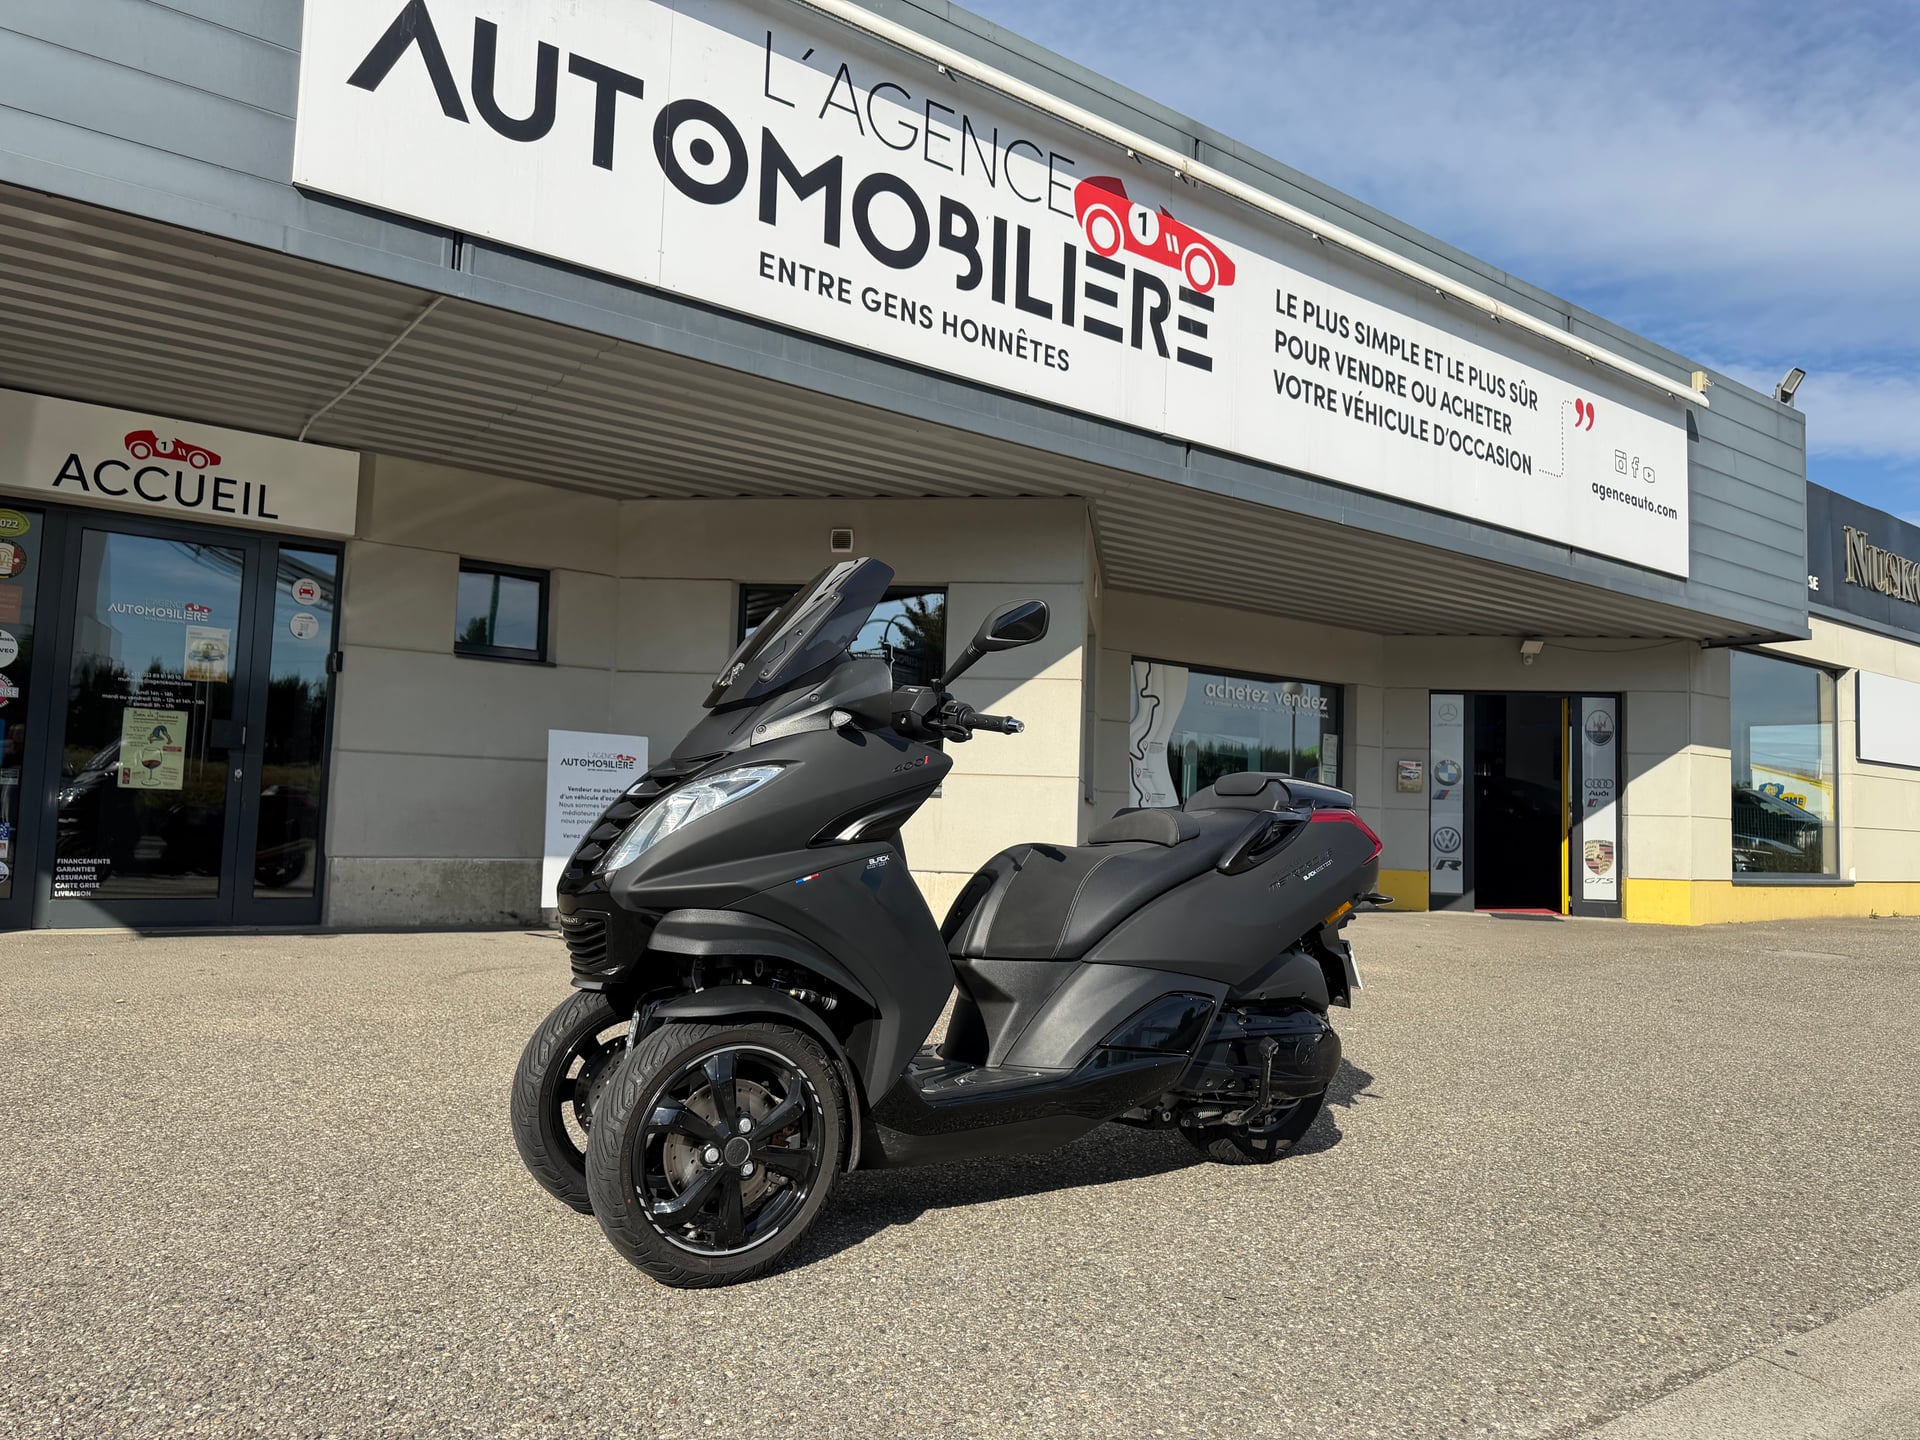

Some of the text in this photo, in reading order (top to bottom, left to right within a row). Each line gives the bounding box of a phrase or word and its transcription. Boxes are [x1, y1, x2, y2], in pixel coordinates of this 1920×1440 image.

[767, 30, 1076, 218] L'AGENCE
[759, 252, 1071, 374] ENTRE GENS HONNÊTES
[1275, 289, 1539, 411] LE PLUS SIMPLE ET LE PLUS SÛR
[1273, 369, 1532, 476] VOTRE VÉHICULE D'OCCASION
[1274, 329, 1513, 436] POUR VENDRE OU ACHETER
[51, 453, 279, 520] ACCUEIL
[1591, 479, 1678, 520] agenceauto.com
[1206, 678, 1269, 705] achetez
[1275, 688, 1328, 711] vendez
[575, 793, 599, 801] véhicule
